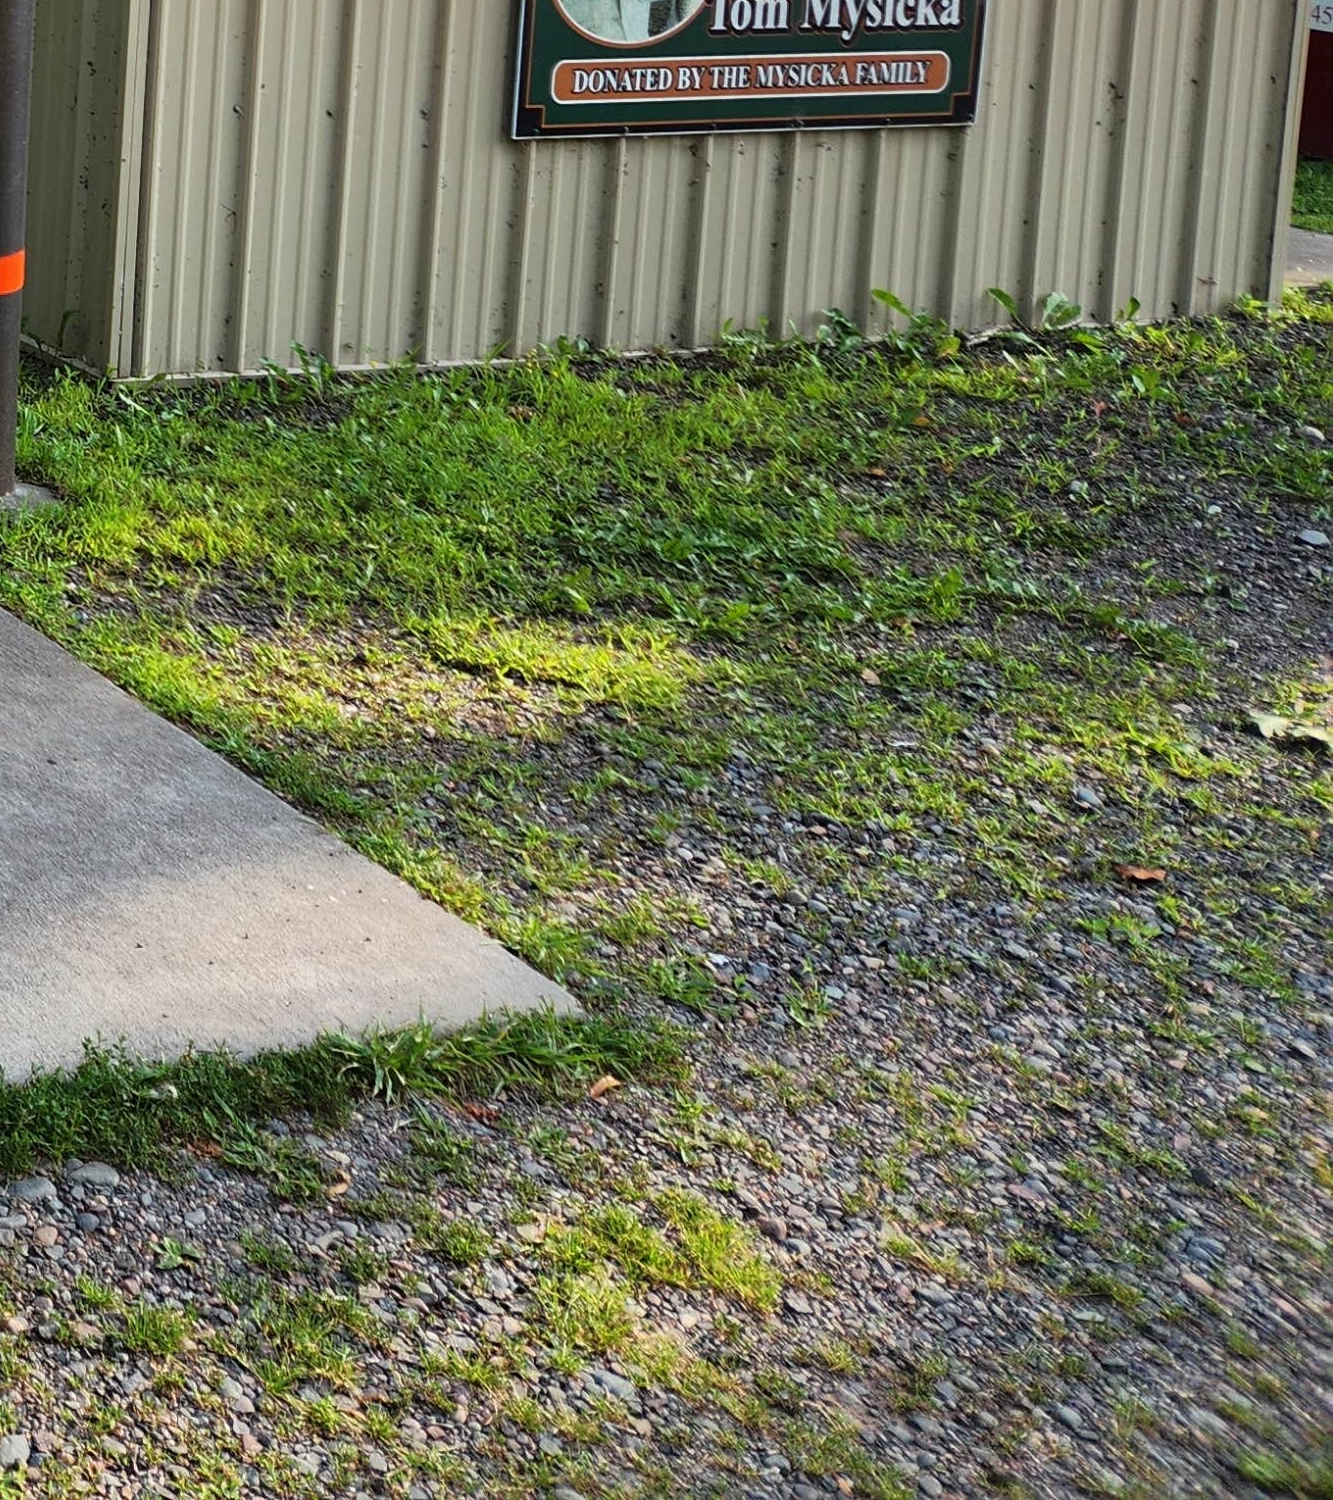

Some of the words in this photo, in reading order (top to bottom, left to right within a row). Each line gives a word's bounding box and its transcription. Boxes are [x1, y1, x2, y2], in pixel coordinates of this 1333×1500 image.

[572, 66, 673, 95] DONATED
[676, 66, 707, 91] BY
[710, 64, 751, 90] THE
[754, 62, 849, 89] MYSICKA
[855, 59, 933, 86] FAMILY
